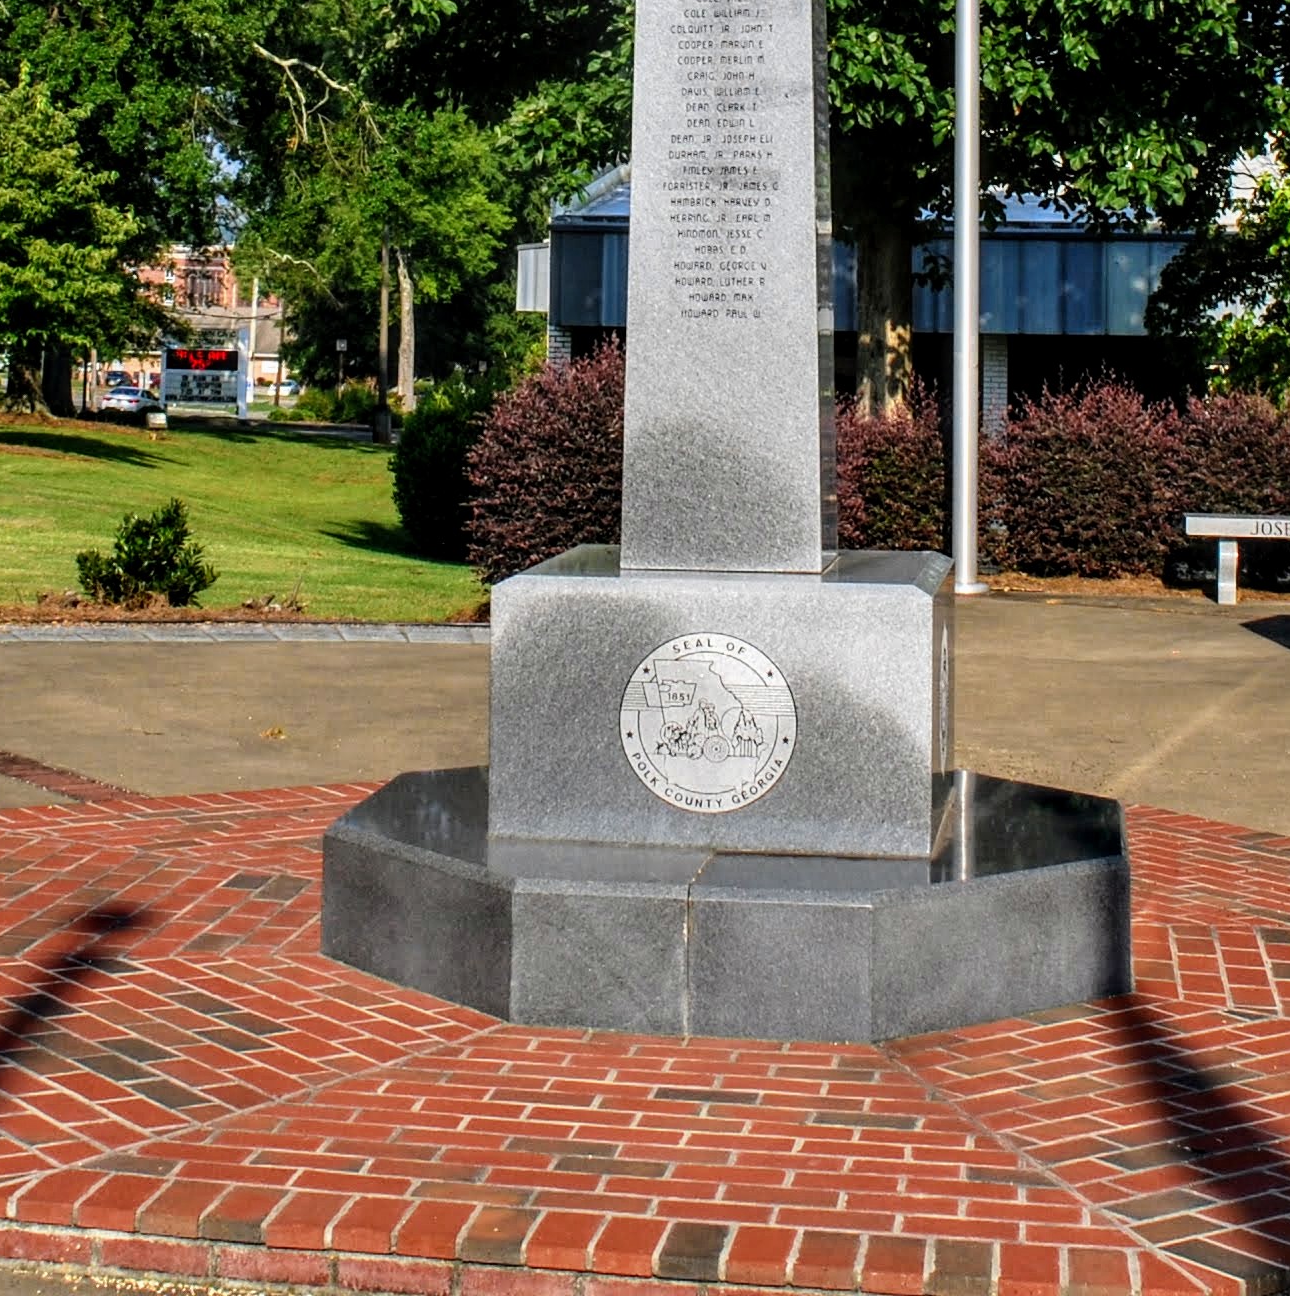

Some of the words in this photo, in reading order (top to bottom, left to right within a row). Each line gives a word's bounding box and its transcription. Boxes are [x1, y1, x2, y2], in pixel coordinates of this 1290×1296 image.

[741, 25, 762, 33] JOHN
[723, 72, 744, 80] JOHN
[722, 135, 755, 143] JOSEPH
[733, 150, 762, 159] PARKS
[724, 198, 760, 206] HARVEY
[727, 230, 751, 238] JESSE
[720, 261, 755, 271] GEORGE
[720, 277, 754, 286] LUTHER
[673, 639, 713, 653] SEAL
[726, 642, 746, 655] OF
[668, 692, 690, 701] 1851
[632, 752, 658, 785] POLK
[665, 788, 722, 807] COUNTY
[731, 759, 783, 804] GEORGIA
